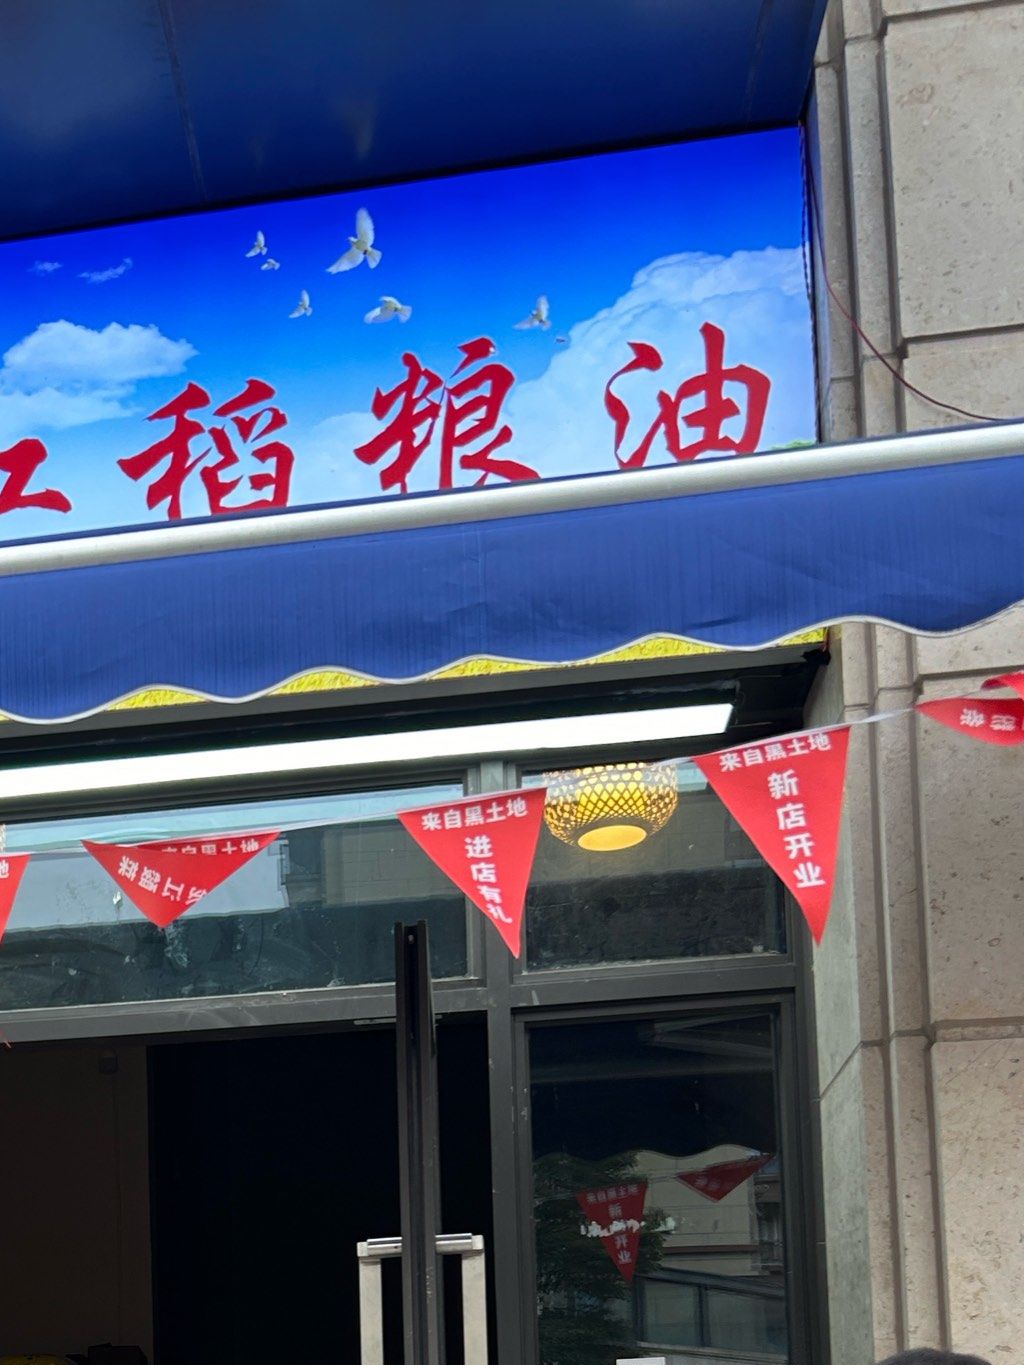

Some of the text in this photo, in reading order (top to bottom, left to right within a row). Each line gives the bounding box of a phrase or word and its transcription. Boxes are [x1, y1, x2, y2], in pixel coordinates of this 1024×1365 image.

[719, 732, 831, 773] 来自黑土地
[422, 797, 529, 831] 来自黑土地
[767, 769, 826, 888] 新店开业
[464, 836, 513, 924] 进店有礼
